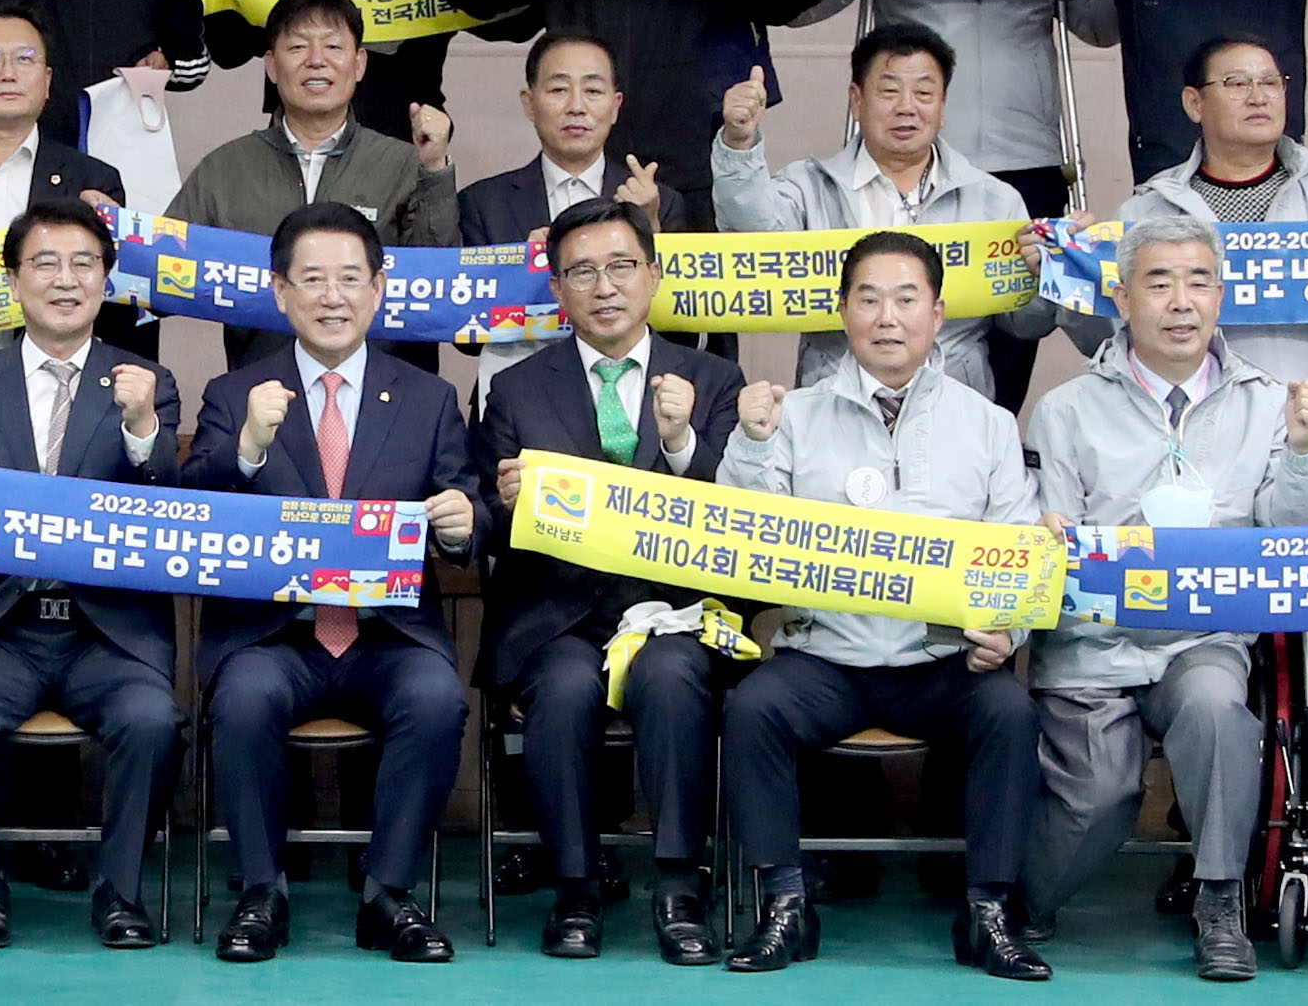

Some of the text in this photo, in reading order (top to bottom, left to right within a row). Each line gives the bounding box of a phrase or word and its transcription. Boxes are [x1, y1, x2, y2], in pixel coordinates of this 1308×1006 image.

[987, 239, 1021, 259] 202
[659, 254, 724, 280] 43회
[451, 273, 497, 304] 해
[672, 289, 772, 317] 제104회
[90, 493, 210, 521] 2022-2023
[535, 521, 582, 543] 전라남도
[606, 485, 954, 568] 제43회 전국장애인체육대회
[4, 510, 320, 585] 전라남도 방문의 해
[971, 547, 1029, 568] 2023
[632, 531, 913, 604] 제104회 전국체육대회
[964, 570, 1028, 589] 전남으로
[969, 591, 1017, 610] 오세요
